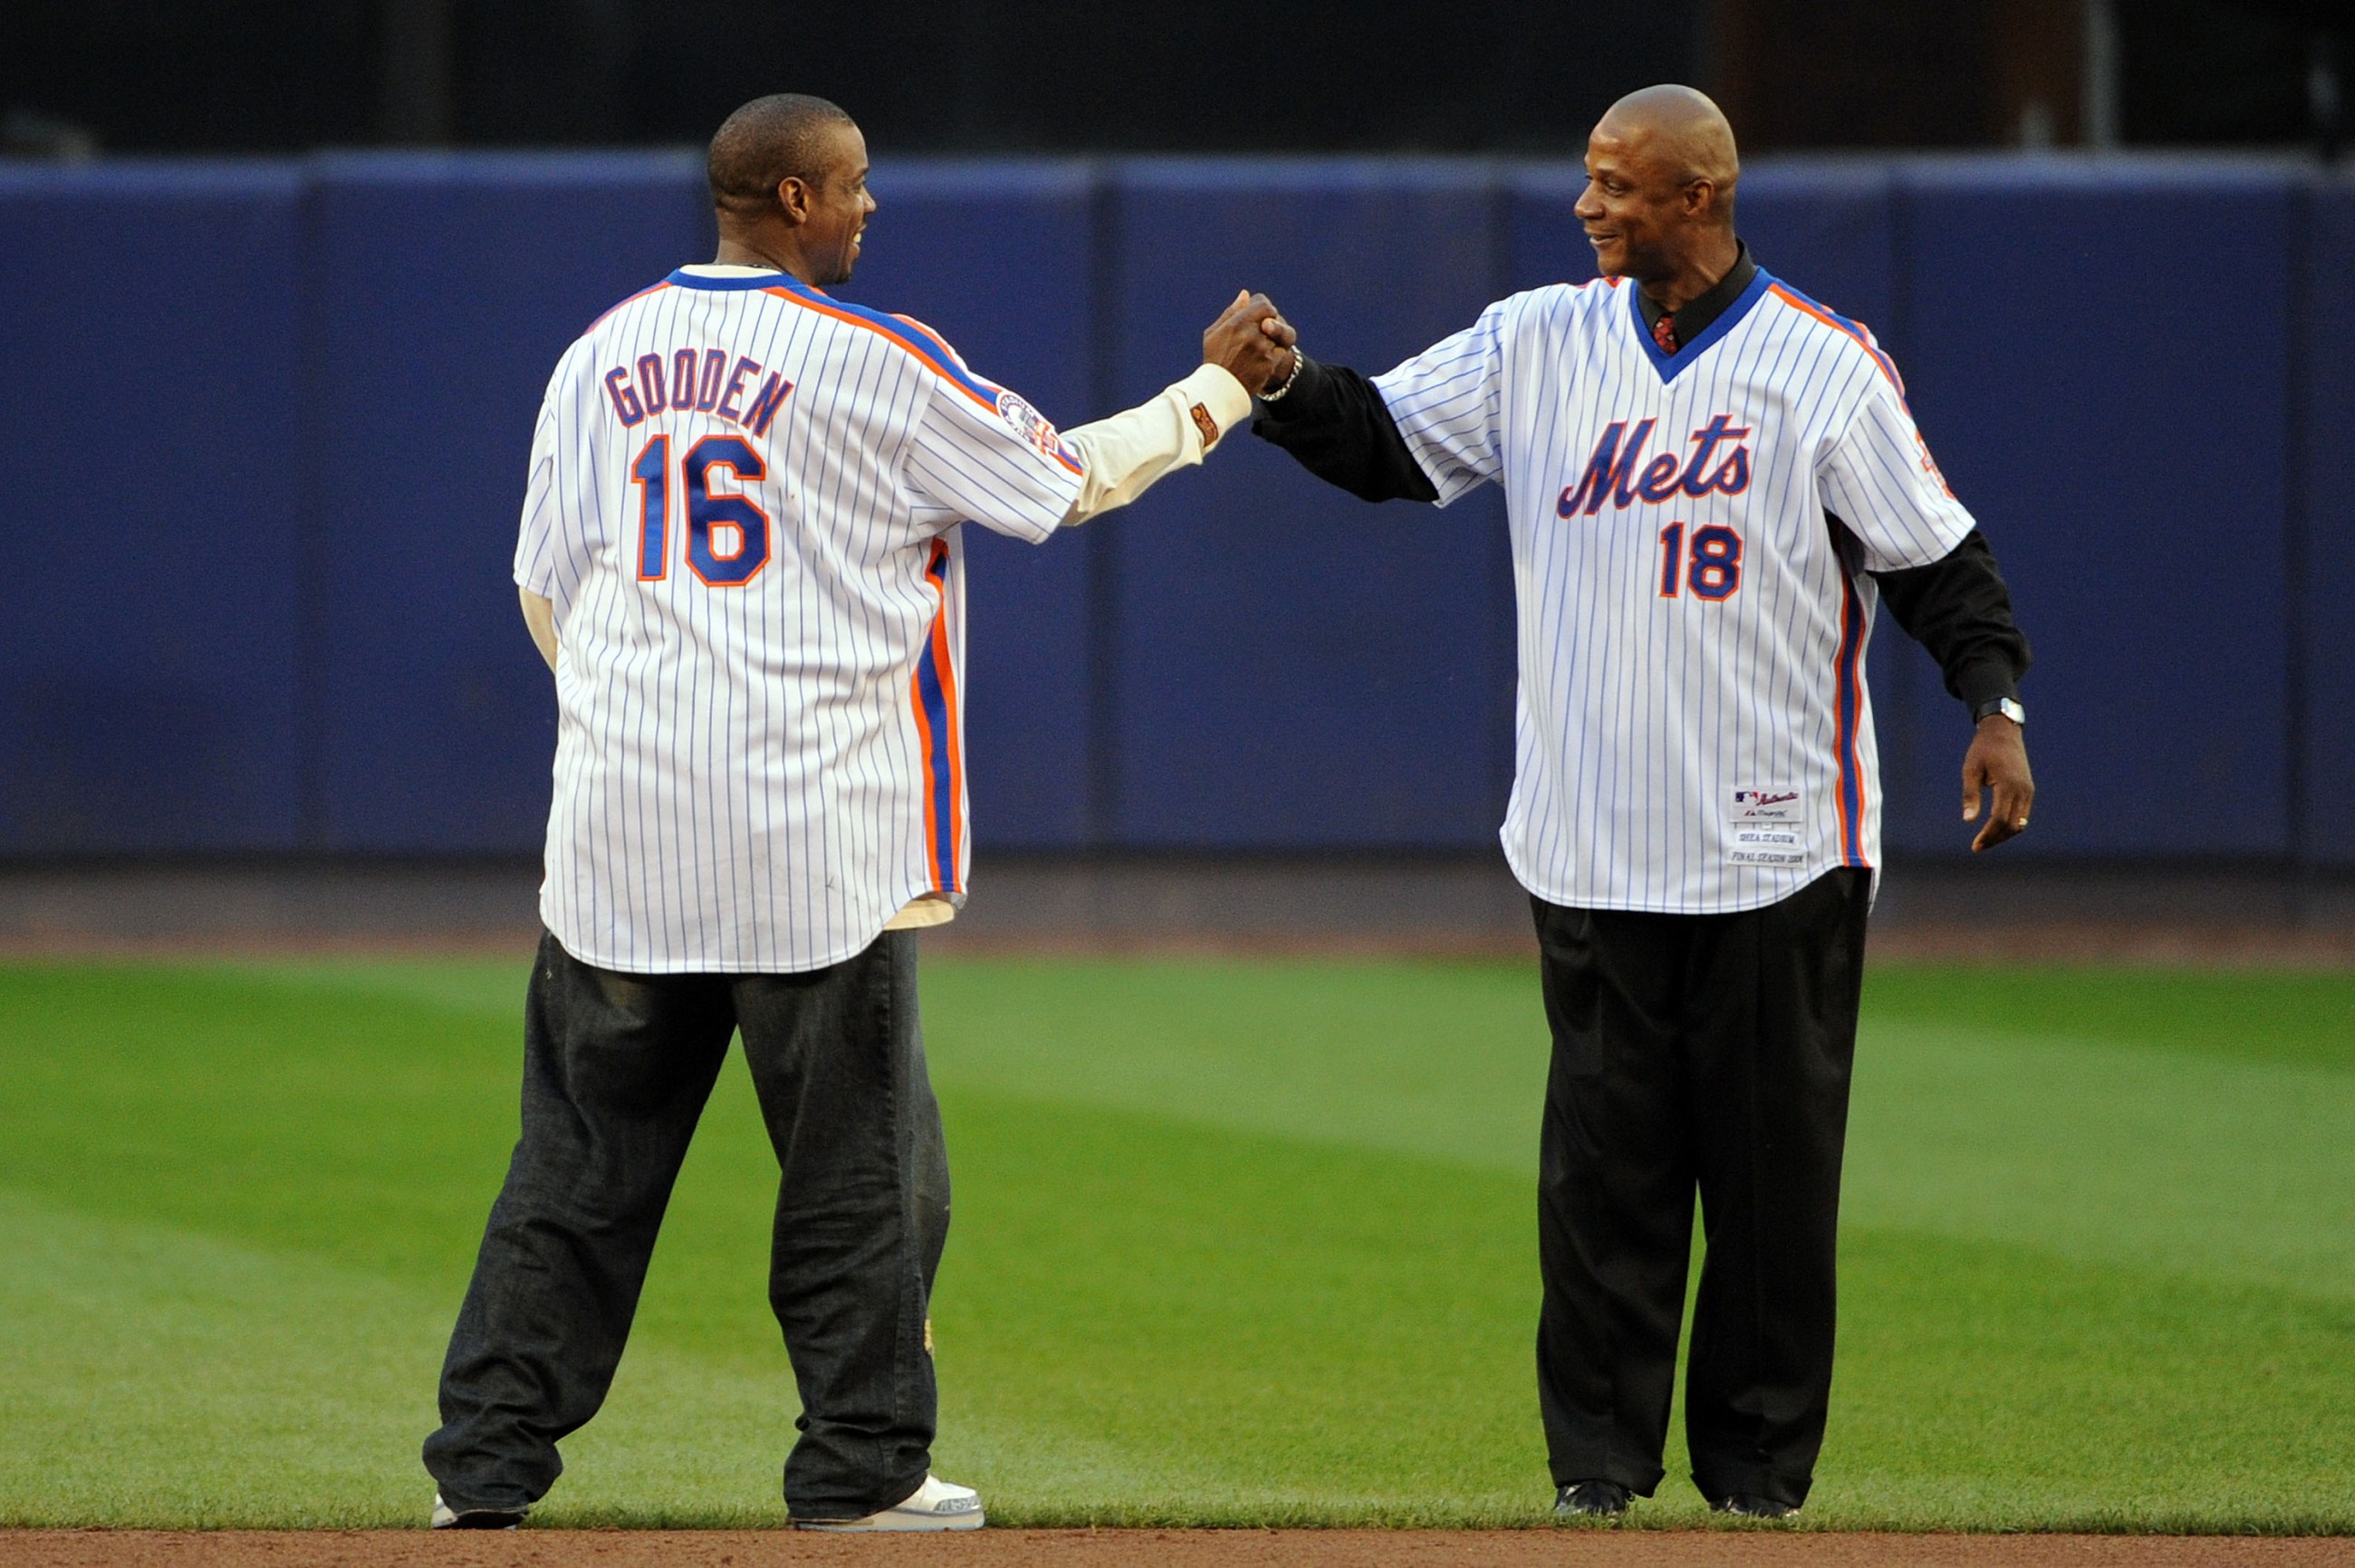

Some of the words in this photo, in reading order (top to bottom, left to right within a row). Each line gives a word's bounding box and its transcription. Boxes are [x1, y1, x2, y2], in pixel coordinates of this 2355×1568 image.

[604, 348, 794, 438] GOODEN
[631, 434, 771, 588] 16
[1557, 414, 1752, 519] Mets
[1659, 521, 1743, 602] 18
